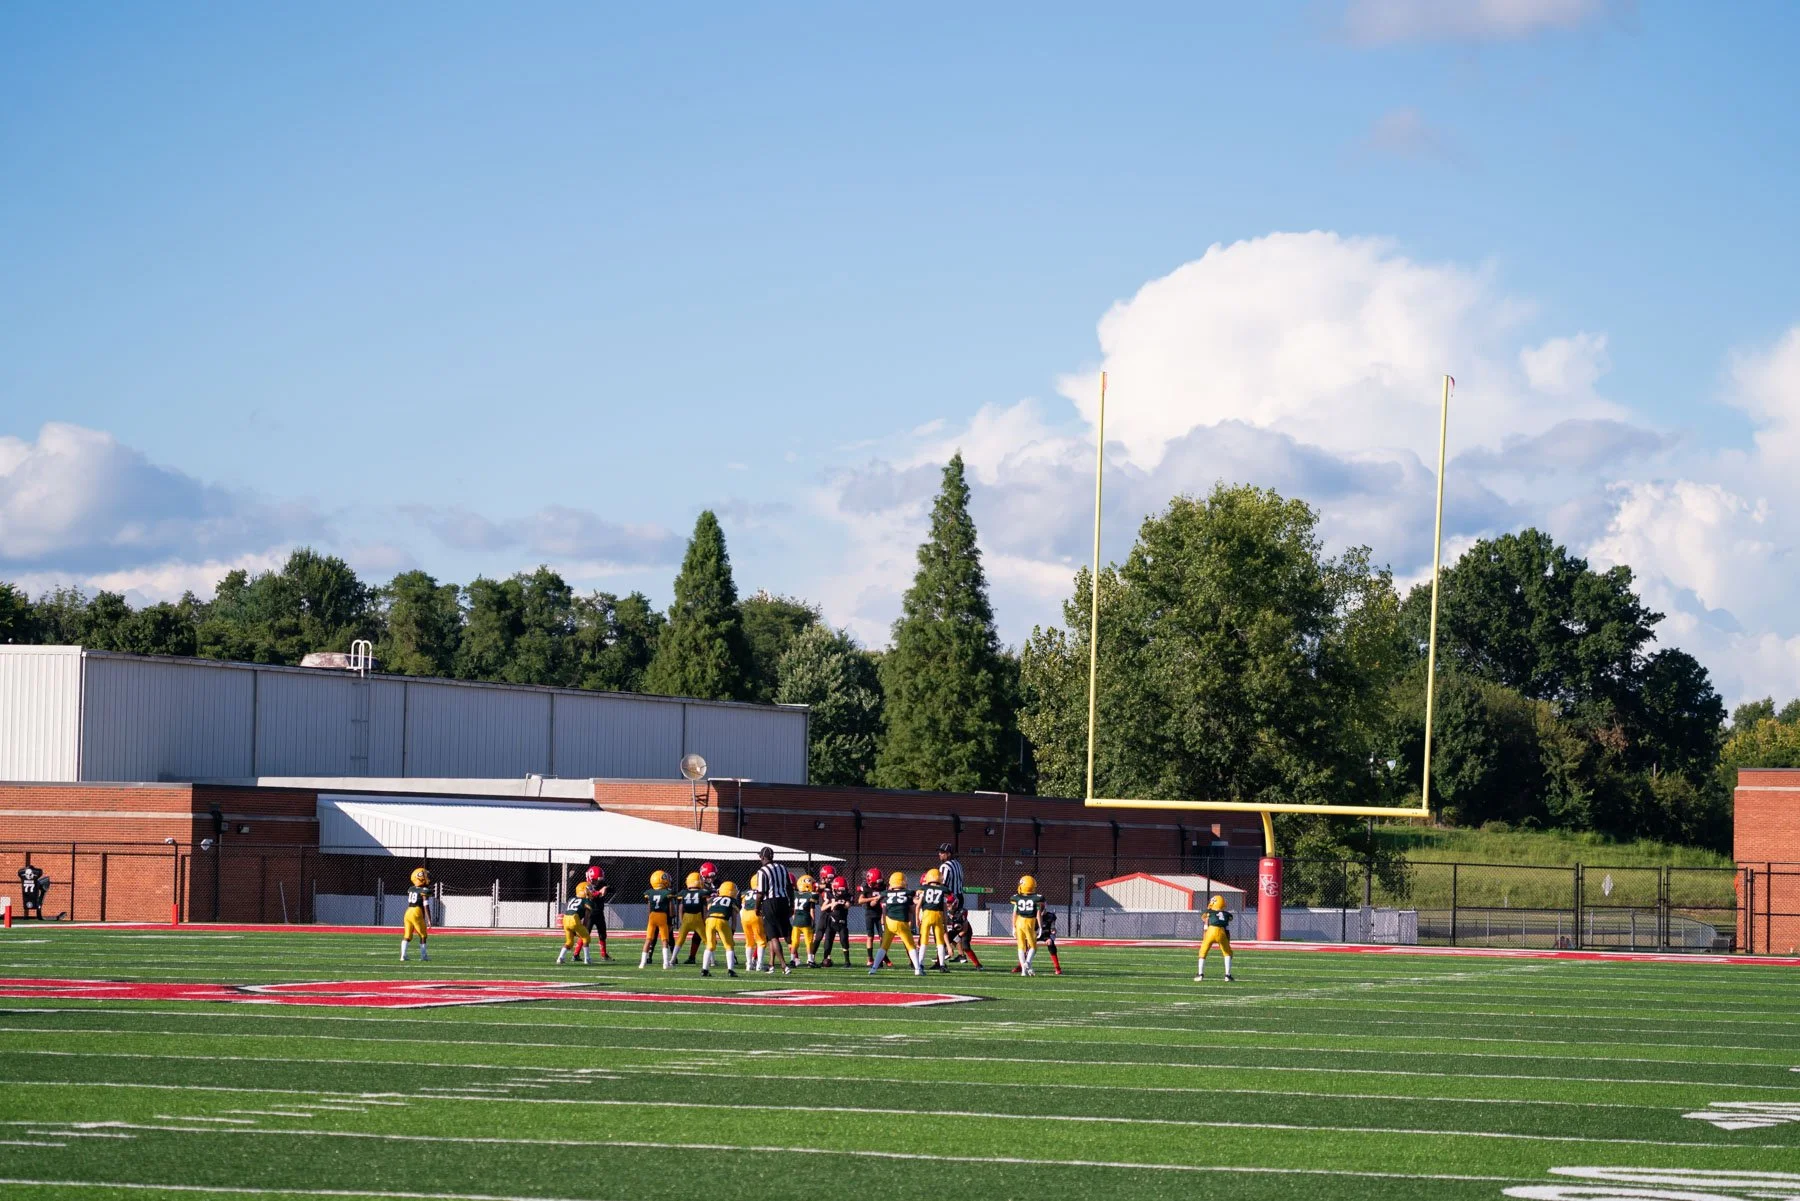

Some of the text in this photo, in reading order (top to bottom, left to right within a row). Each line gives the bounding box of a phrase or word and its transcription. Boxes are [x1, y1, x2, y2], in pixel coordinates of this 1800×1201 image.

[23, 883, 35, 893] 77
[408, 891, 418, 904] 18
[653, 895, 661, 909] 7
[684, 893, 699, 904] 44
[712, 896, 731, 907] 70
[886, 892, 908, 904] 75
[925, 888, 943, 904] 87
[567, 898, 582, 911] 12
[794, 897, 807, 911] 17
